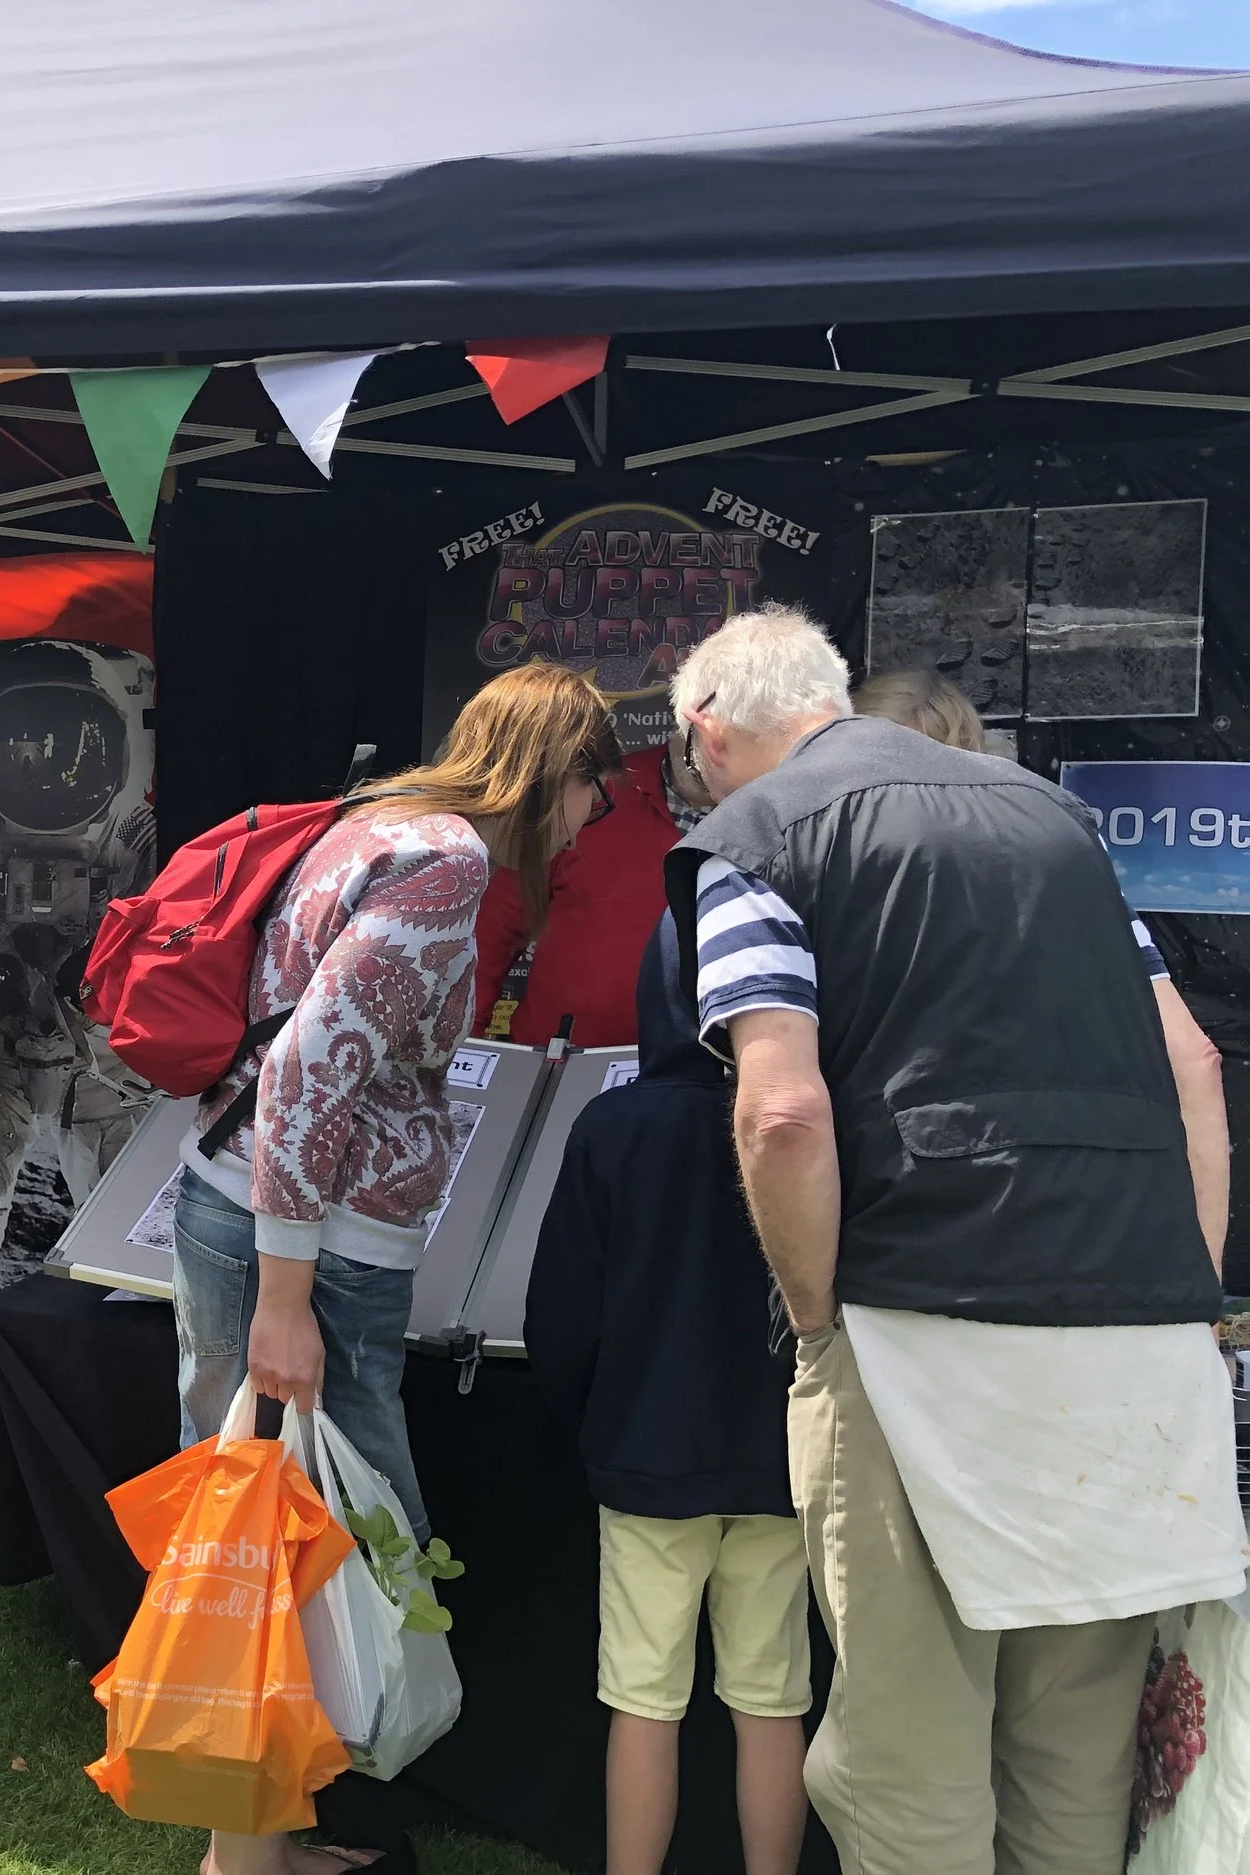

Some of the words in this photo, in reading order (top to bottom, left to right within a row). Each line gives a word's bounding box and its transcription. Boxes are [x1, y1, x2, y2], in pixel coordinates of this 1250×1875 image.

[438, 501, 546, 572] FREE!
[702, 487, 821, 556] FREE!
[501, 543, 563, 568] THAT
[565, 530, 760, 568] ADVENT
[488, 567, 756, 621] PUPPET
[477, 617, 725, 666] CALEND
[197, 1586, 249, 1619] well
